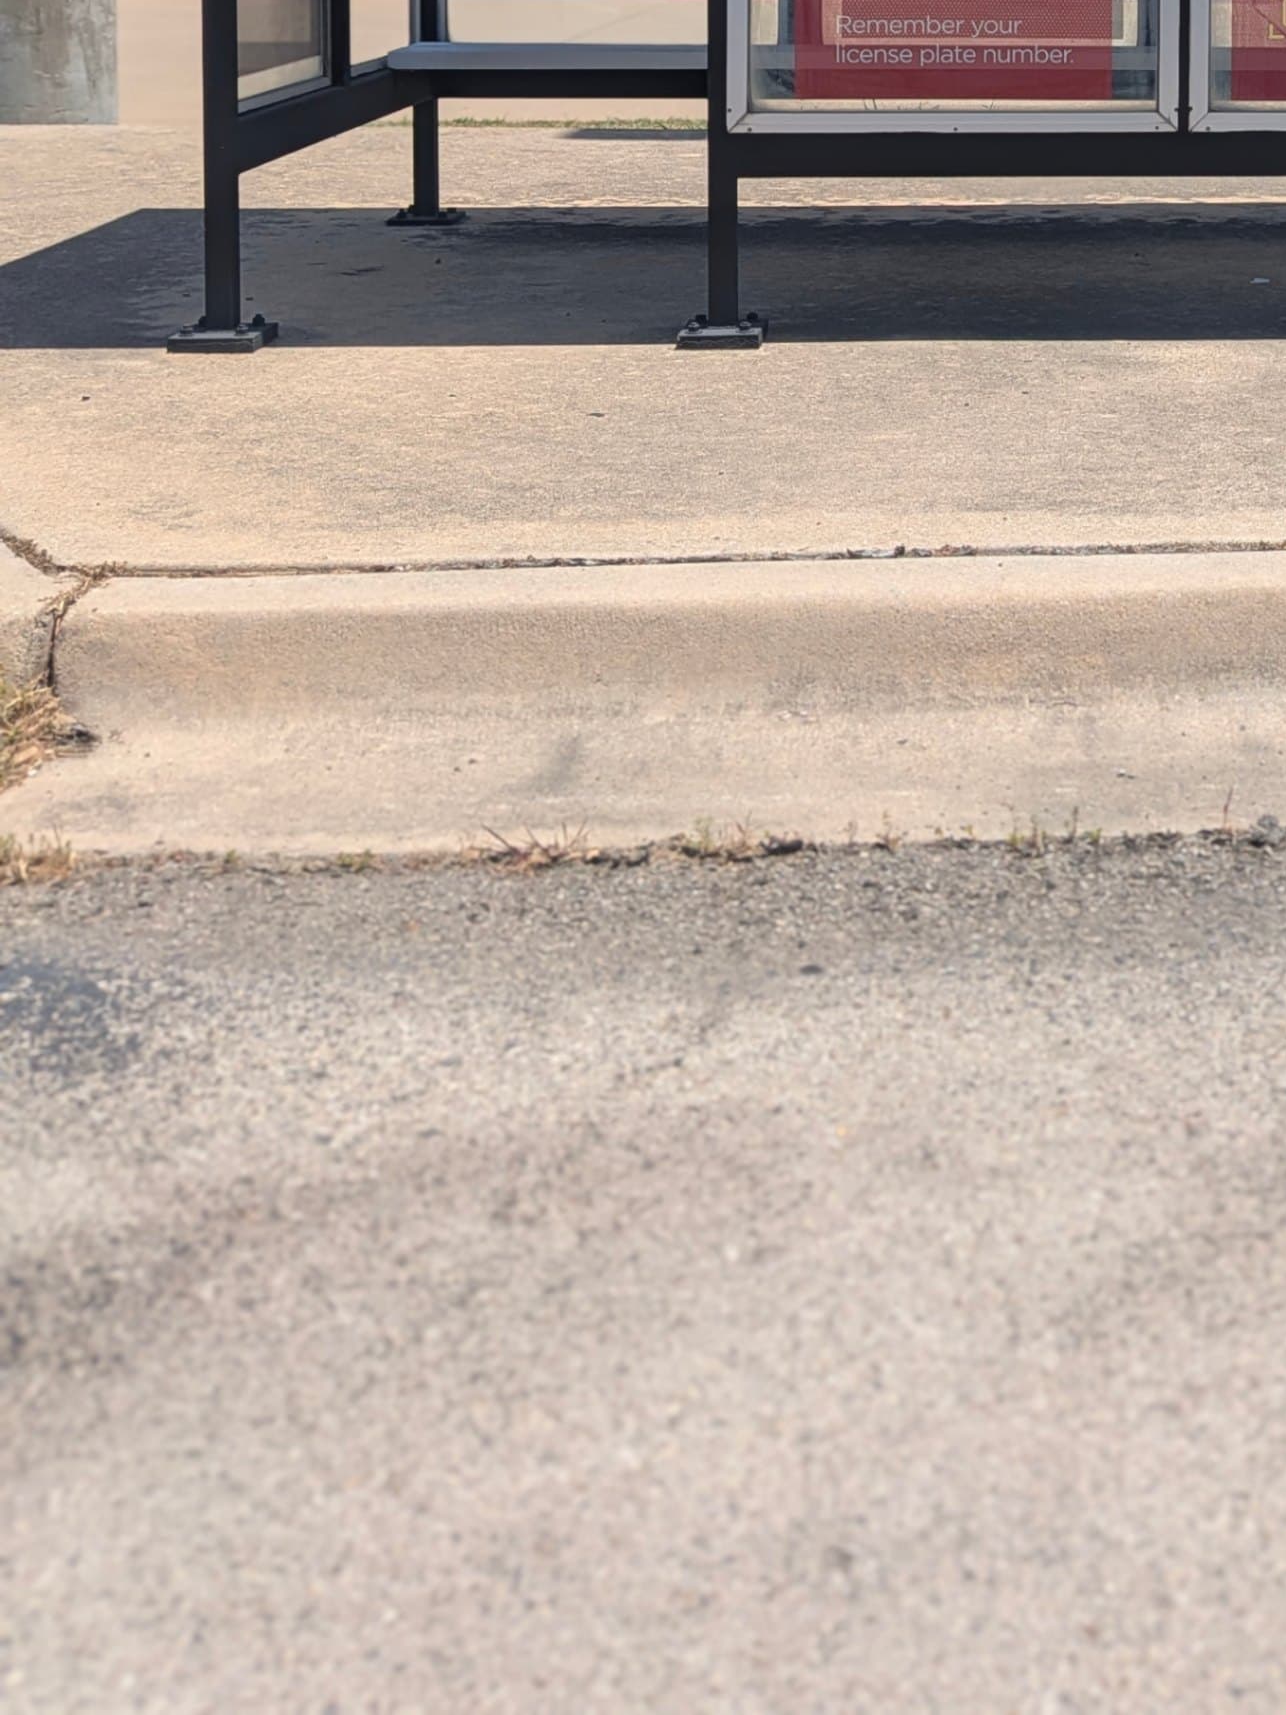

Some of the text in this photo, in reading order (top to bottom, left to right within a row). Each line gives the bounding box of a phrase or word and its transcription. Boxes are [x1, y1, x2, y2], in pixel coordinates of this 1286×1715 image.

[836, 15, 1023, 38] Remember your
[836, 43, 1074, 67] license plate number.
